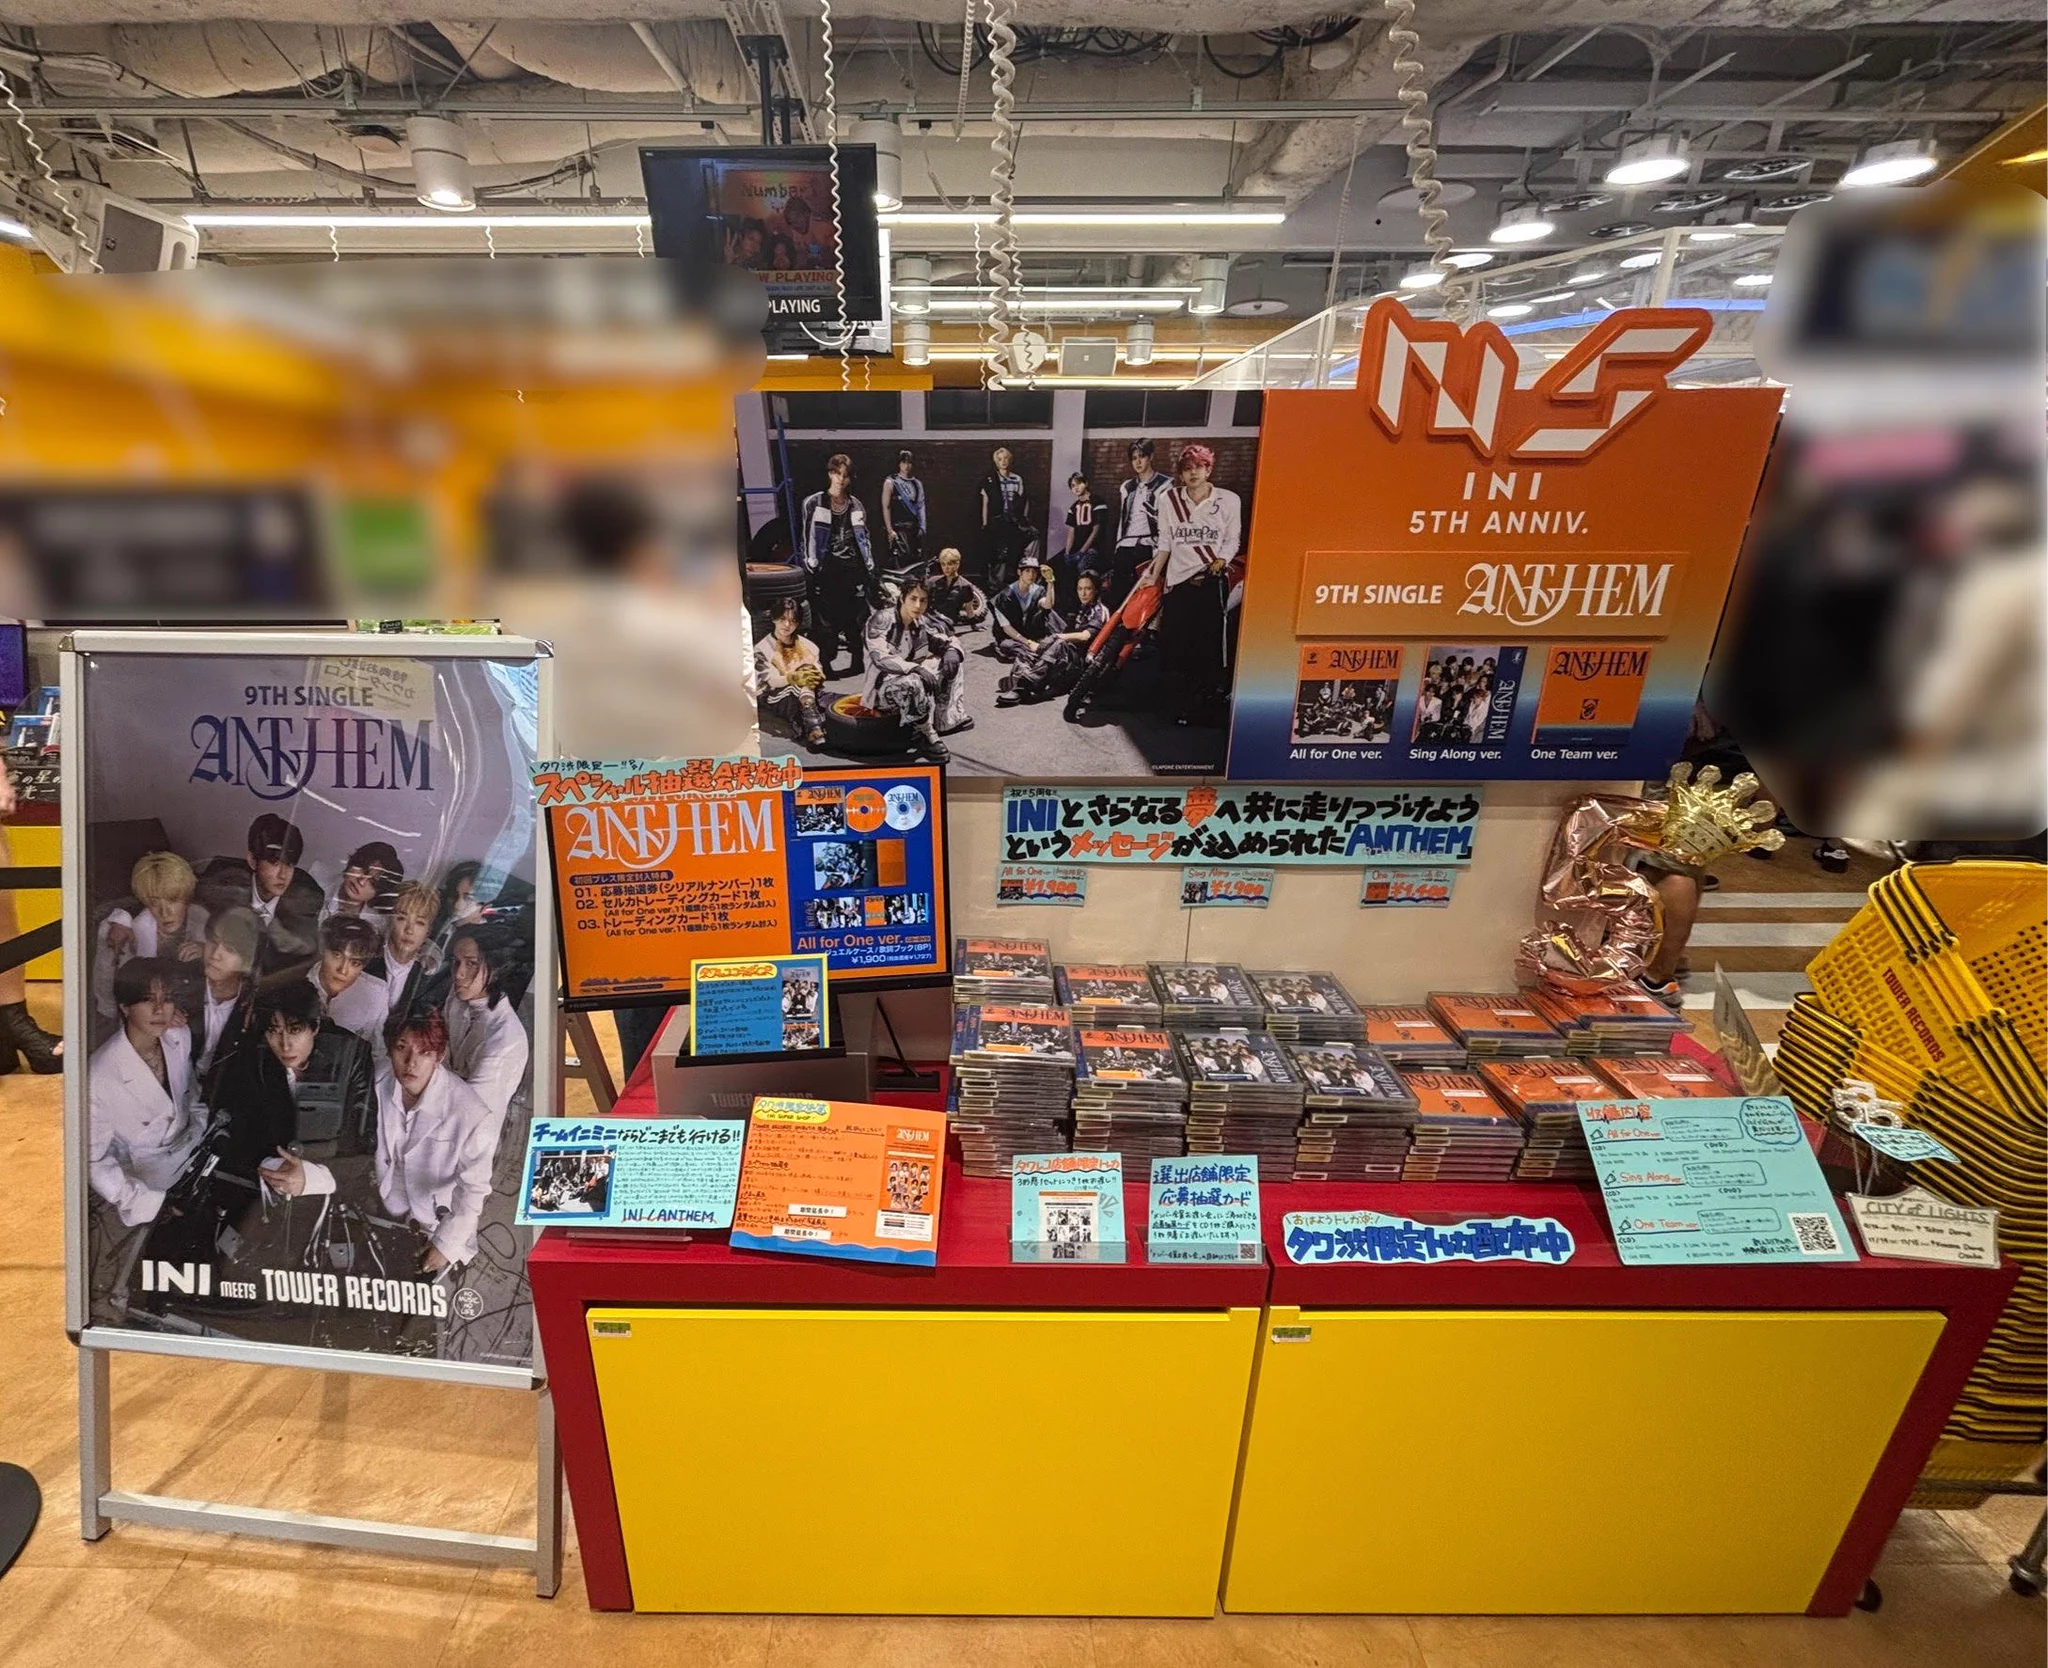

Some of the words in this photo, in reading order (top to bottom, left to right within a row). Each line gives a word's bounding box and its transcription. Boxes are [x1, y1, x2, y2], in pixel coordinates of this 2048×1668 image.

[775, 272, 834, 285] PLAYING
[1463, 472, 1543, 501] INI
[1075, 504, 1091, 526] 10
[1409, 511, 1468, 534] 5TH
[1483, 511, 1589, 534] ANNIV.
[1315, 585, 1361, 604] 9TH
[1364, 584, 1443, 604] SINGLE
[1457, 562, 1674, 626] ANTHEM
[1329, 649, 1399, 673] ANTHEM
[1552, 651, 1649, 681] ANTHEM
[244, 685, 288, 706] 9TH
[294, 686, 375, 707] SINGLE
[188, 714, 435, 801] ANTHEM
[1290, 749, 1309, 759] All
[1310, 749, 1328, 759] for
[1331, 749, 1357, 759] One
[1360, 751, 1383, 759] ver.
[1409, 749, 1437, 762] Sing
[1440, 749, 1476, 762] Along
[1531, 749, 1556, 759] One
[1560, 749, 1592, 759] Team
[1596, 751, 1618, 759] ver.
[532, 757, 802, 805] スペシャル抽選会実施中
[565, 799, 777, 870] ANTHEM
[575, 887, 597, 898] 01.
[576, 900, 598, 910] 02.
[578, 919, 600, 930] 03.
[797, 937, 816, 950] All
[819, 936, 840, 948] for
[843, 934, 874, 947] One
[877, 934, 904, 945] ver.
[1882, 967, 1908, 1011] TOWER
[1905, 1006, 1946, 1063] RECORDS
[1620, 1171, 1644, 1184] Sing
[1159, 1187, 1252, 1207] 応募抽選カード
[656, 1209, 715, 1223] ANTHEM
[1866, 1201, 1903, 1214] CITY
[1929, 1205, 1988, 1222] LIGHTS
[1634, 1218, 1655, 1229] One
[142, 1260, 211, 1296] INI
[220, 1281, 256, 1300] MEETS
[262, 1269, 339, 1308] TOWER
[345, 1276, 447, 1318] RECORDS
